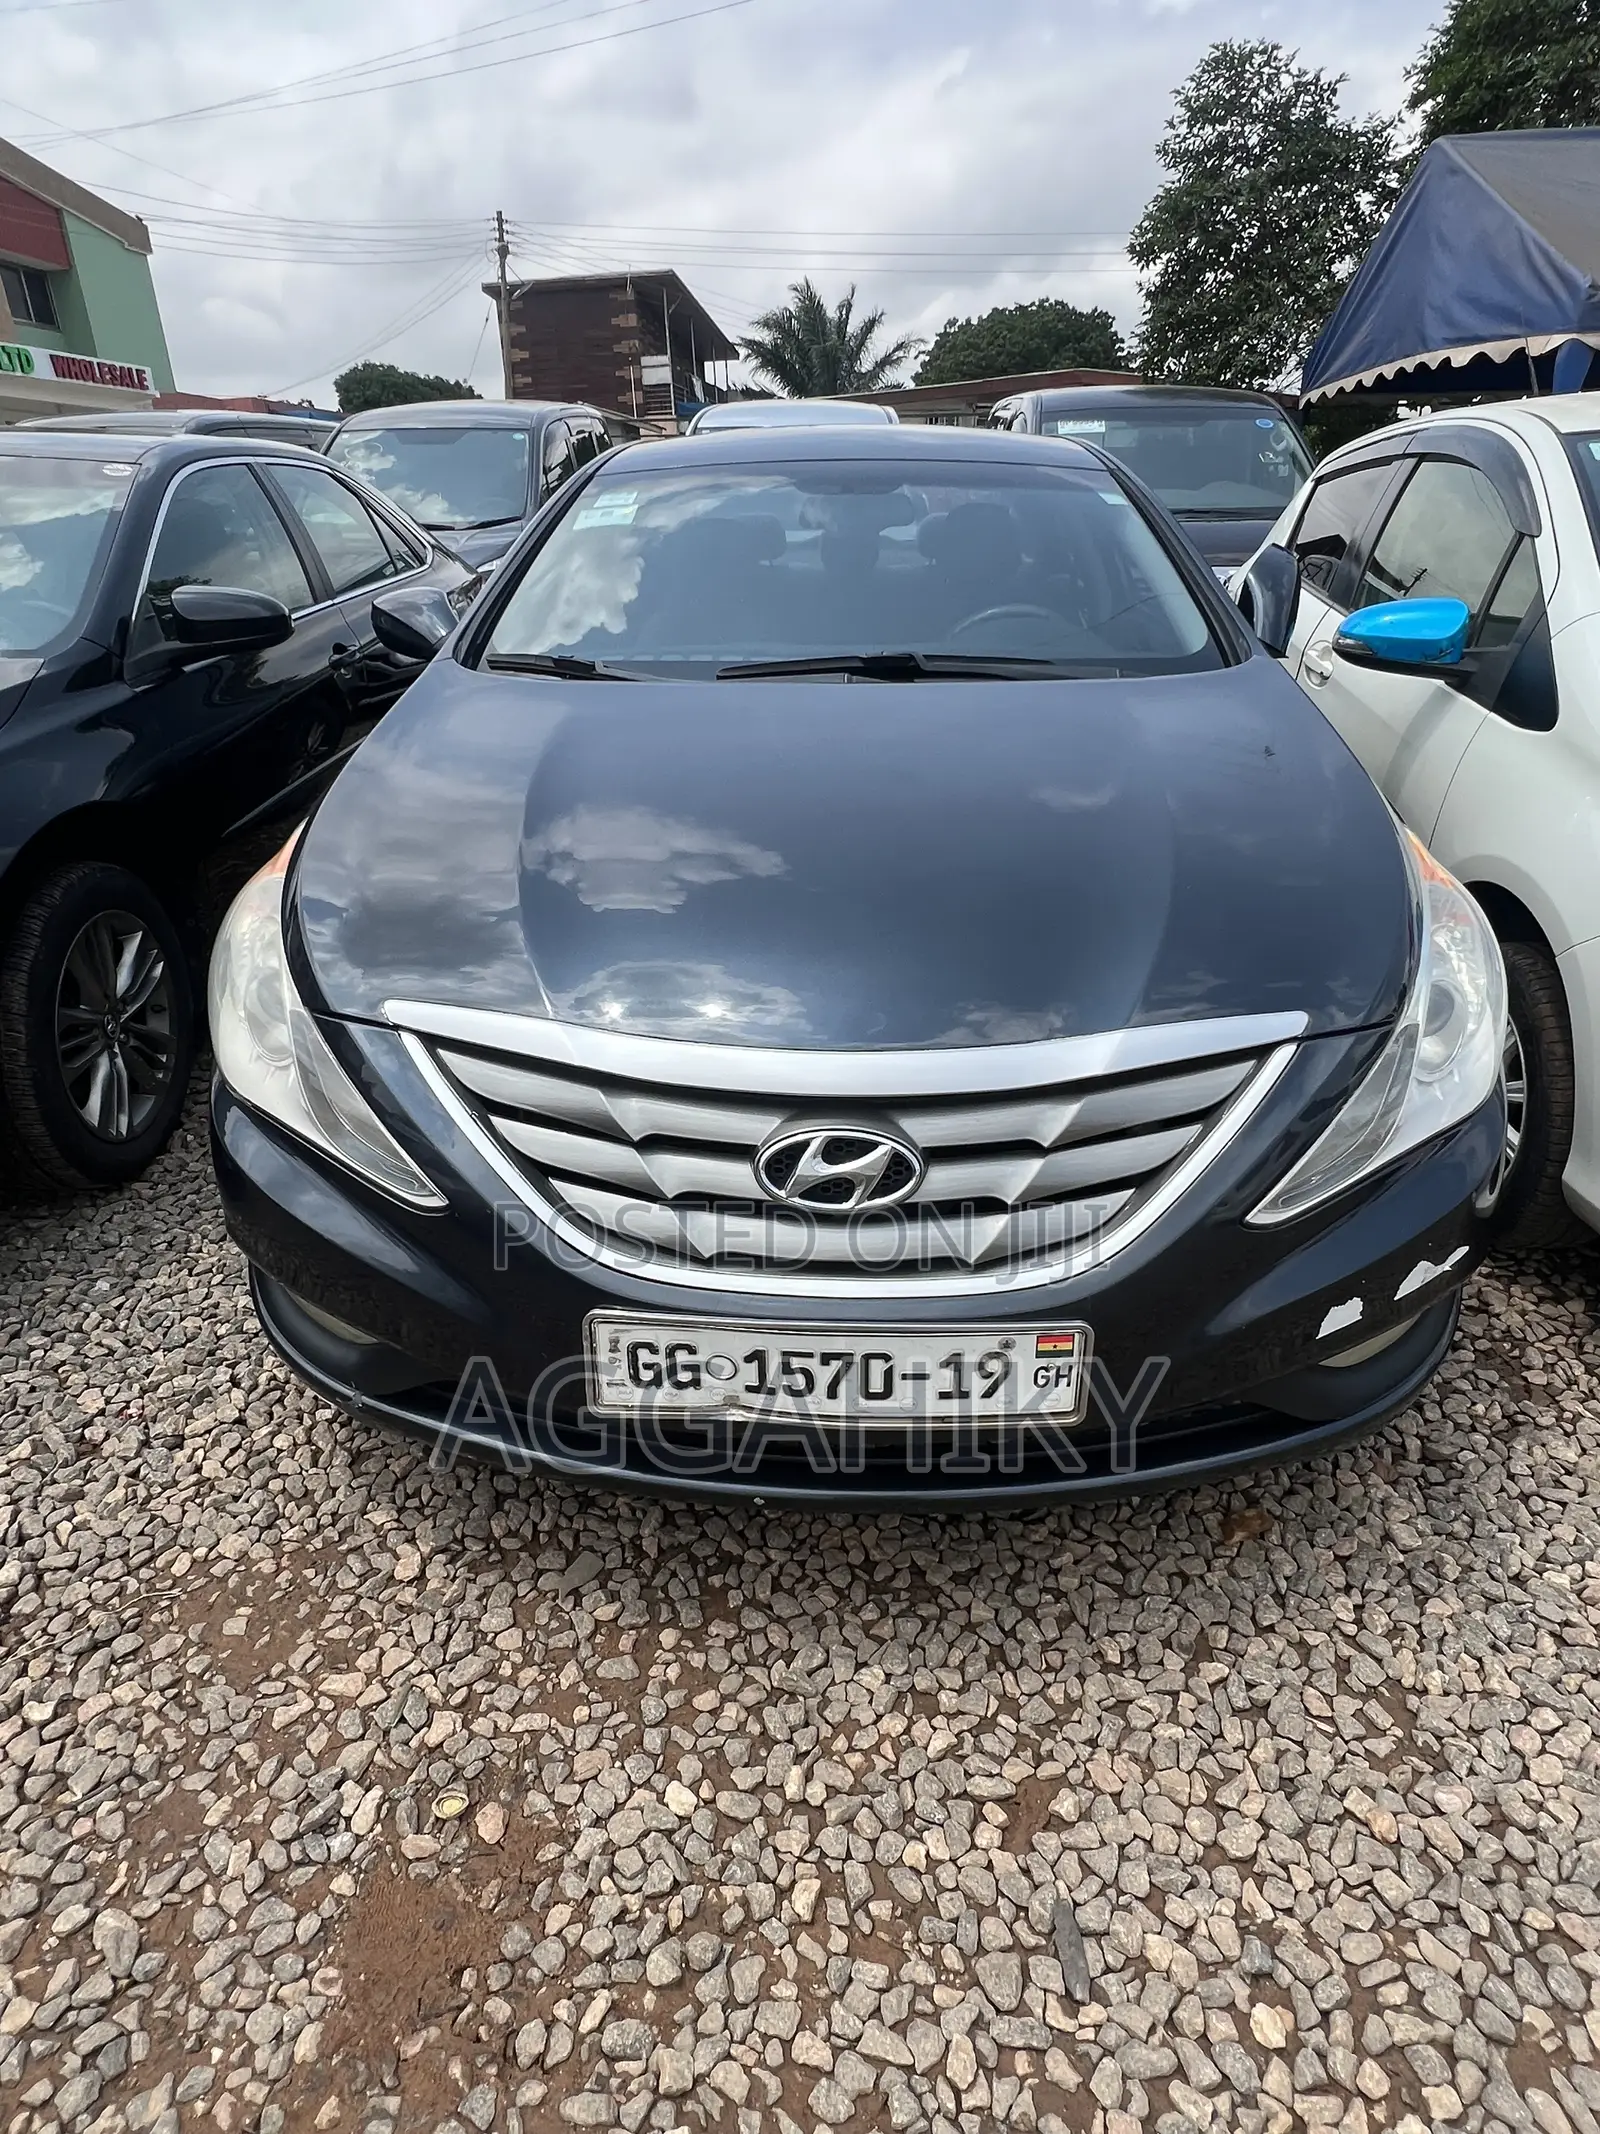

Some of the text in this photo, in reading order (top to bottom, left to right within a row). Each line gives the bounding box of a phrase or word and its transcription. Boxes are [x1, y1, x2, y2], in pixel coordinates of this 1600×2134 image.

[0, 345, 149, 390] LTD WHOLESALE
[626, 1340, 1012, 1401] GG 1570-19
[1033, 1365, 1073, 1389] GH
